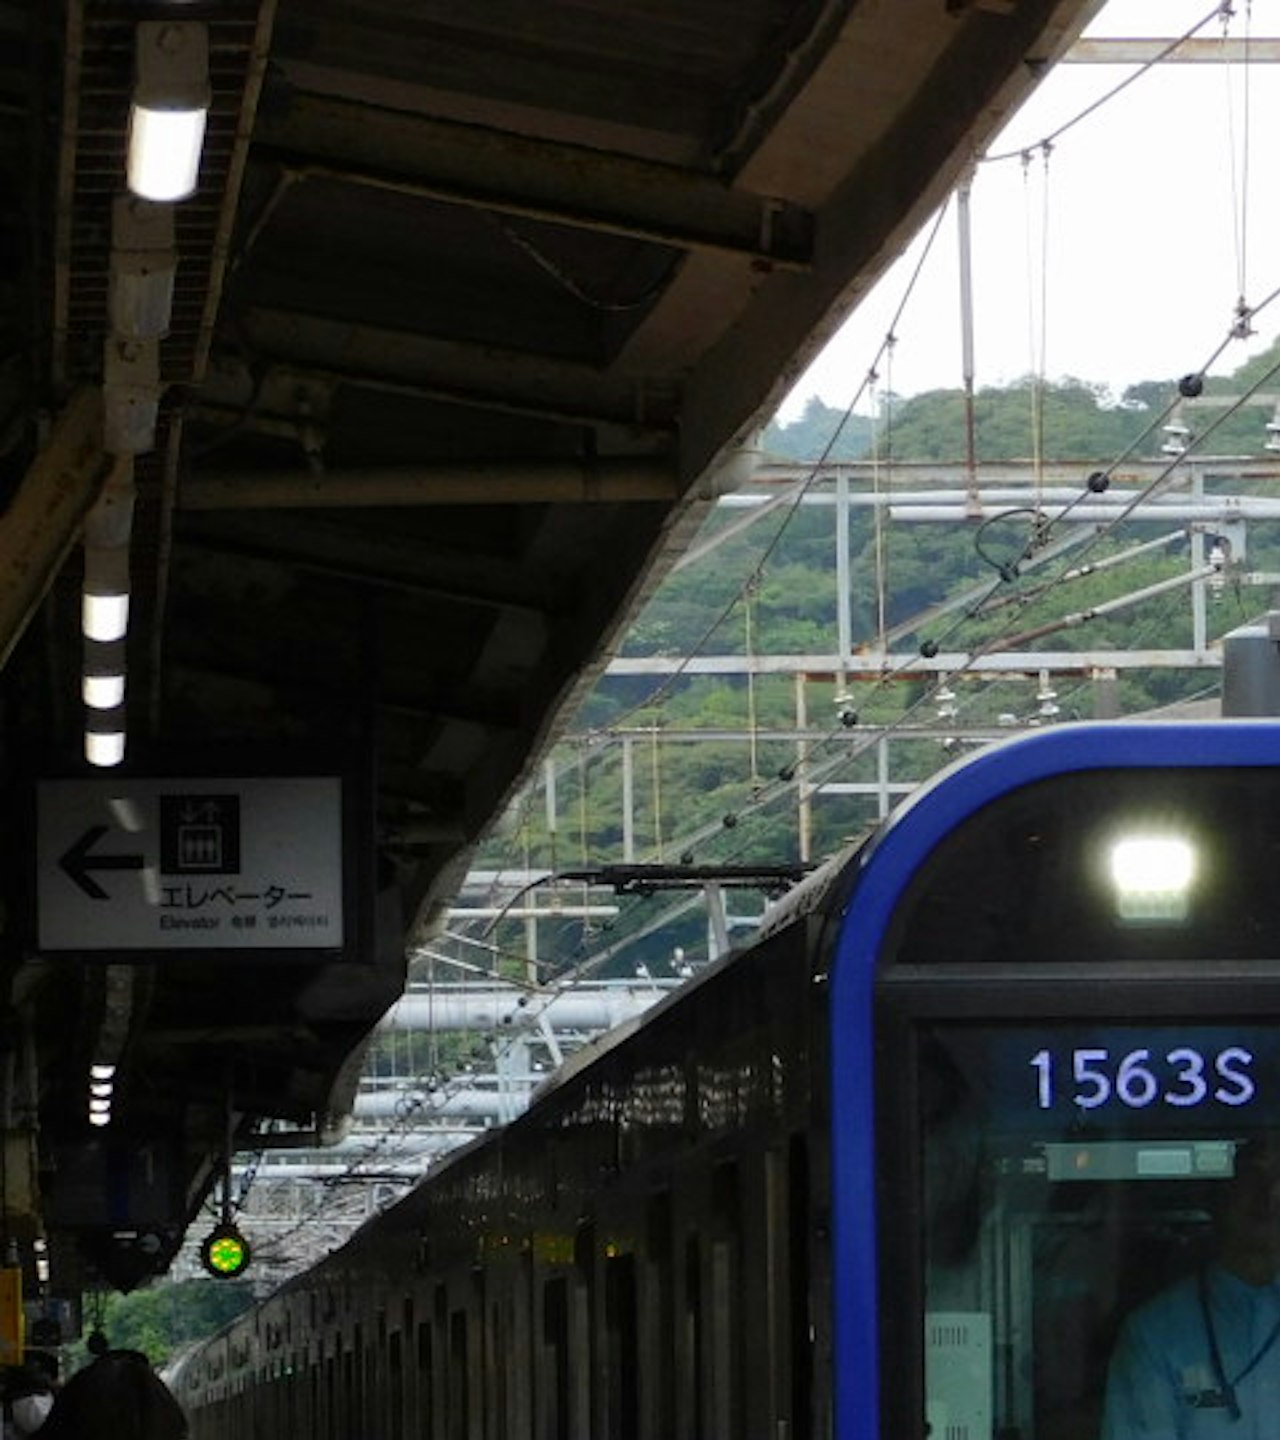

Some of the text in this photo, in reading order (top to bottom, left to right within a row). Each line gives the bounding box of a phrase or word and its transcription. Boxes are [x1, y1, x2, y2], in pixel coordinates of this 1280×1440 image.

[160, 884, 312, 910] エレベーター
[159, 914, 221, 931] Elevator
[1030, 1048, 1256, 1109] 1563S
